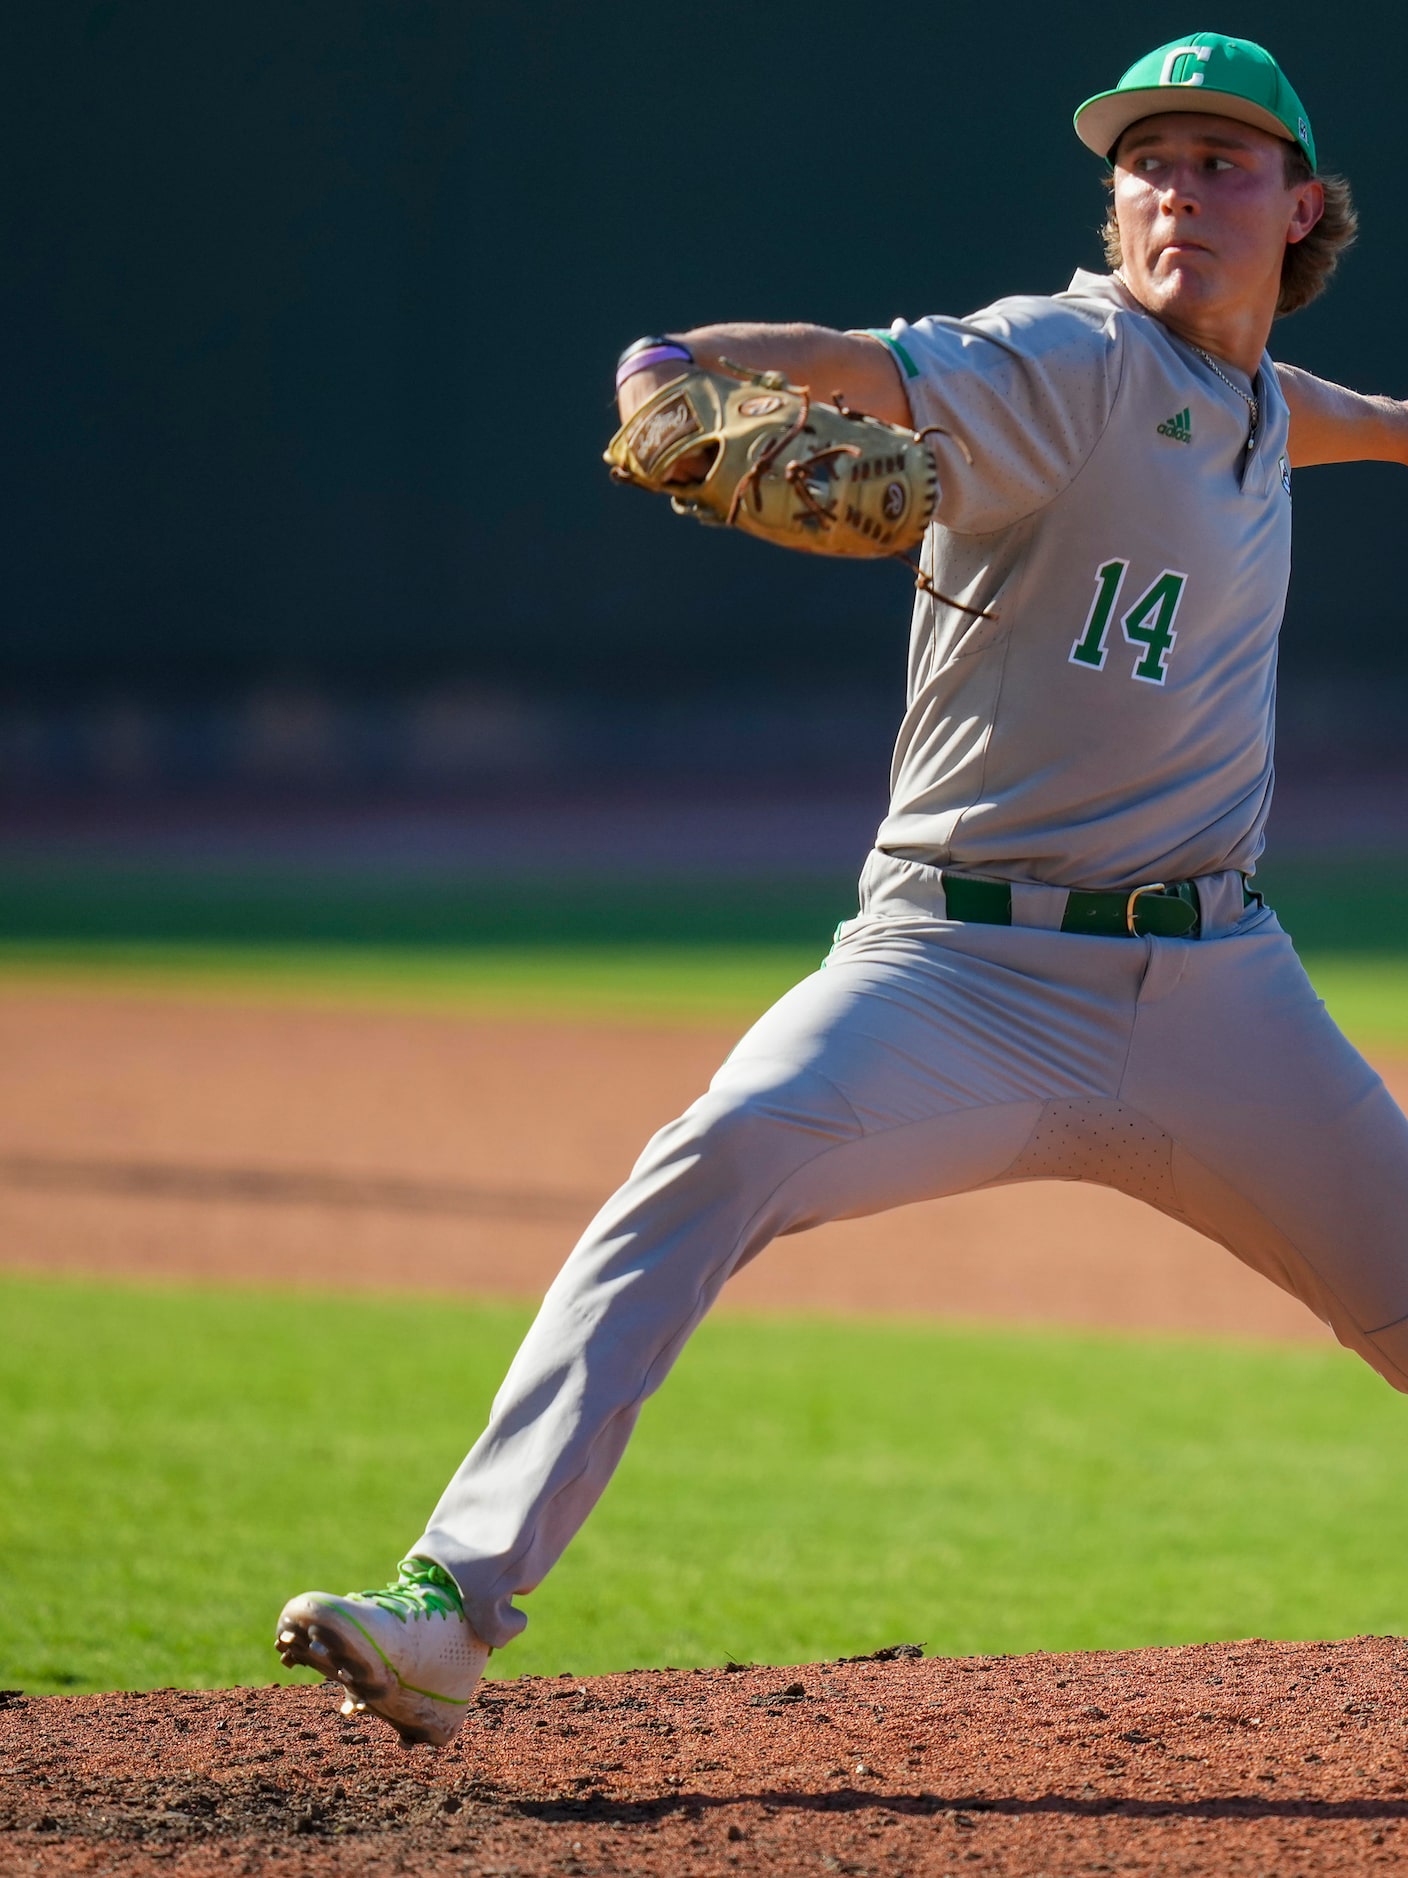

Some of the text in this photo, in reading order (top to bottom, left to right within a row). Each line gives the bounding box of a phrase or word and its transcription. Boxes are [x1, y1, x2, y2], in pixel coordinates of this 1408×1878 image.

[1159, 45, 1212, 86] C
[1157, 424, 1192, 444] adidas
[1068, 557, 1189, 686] 14
